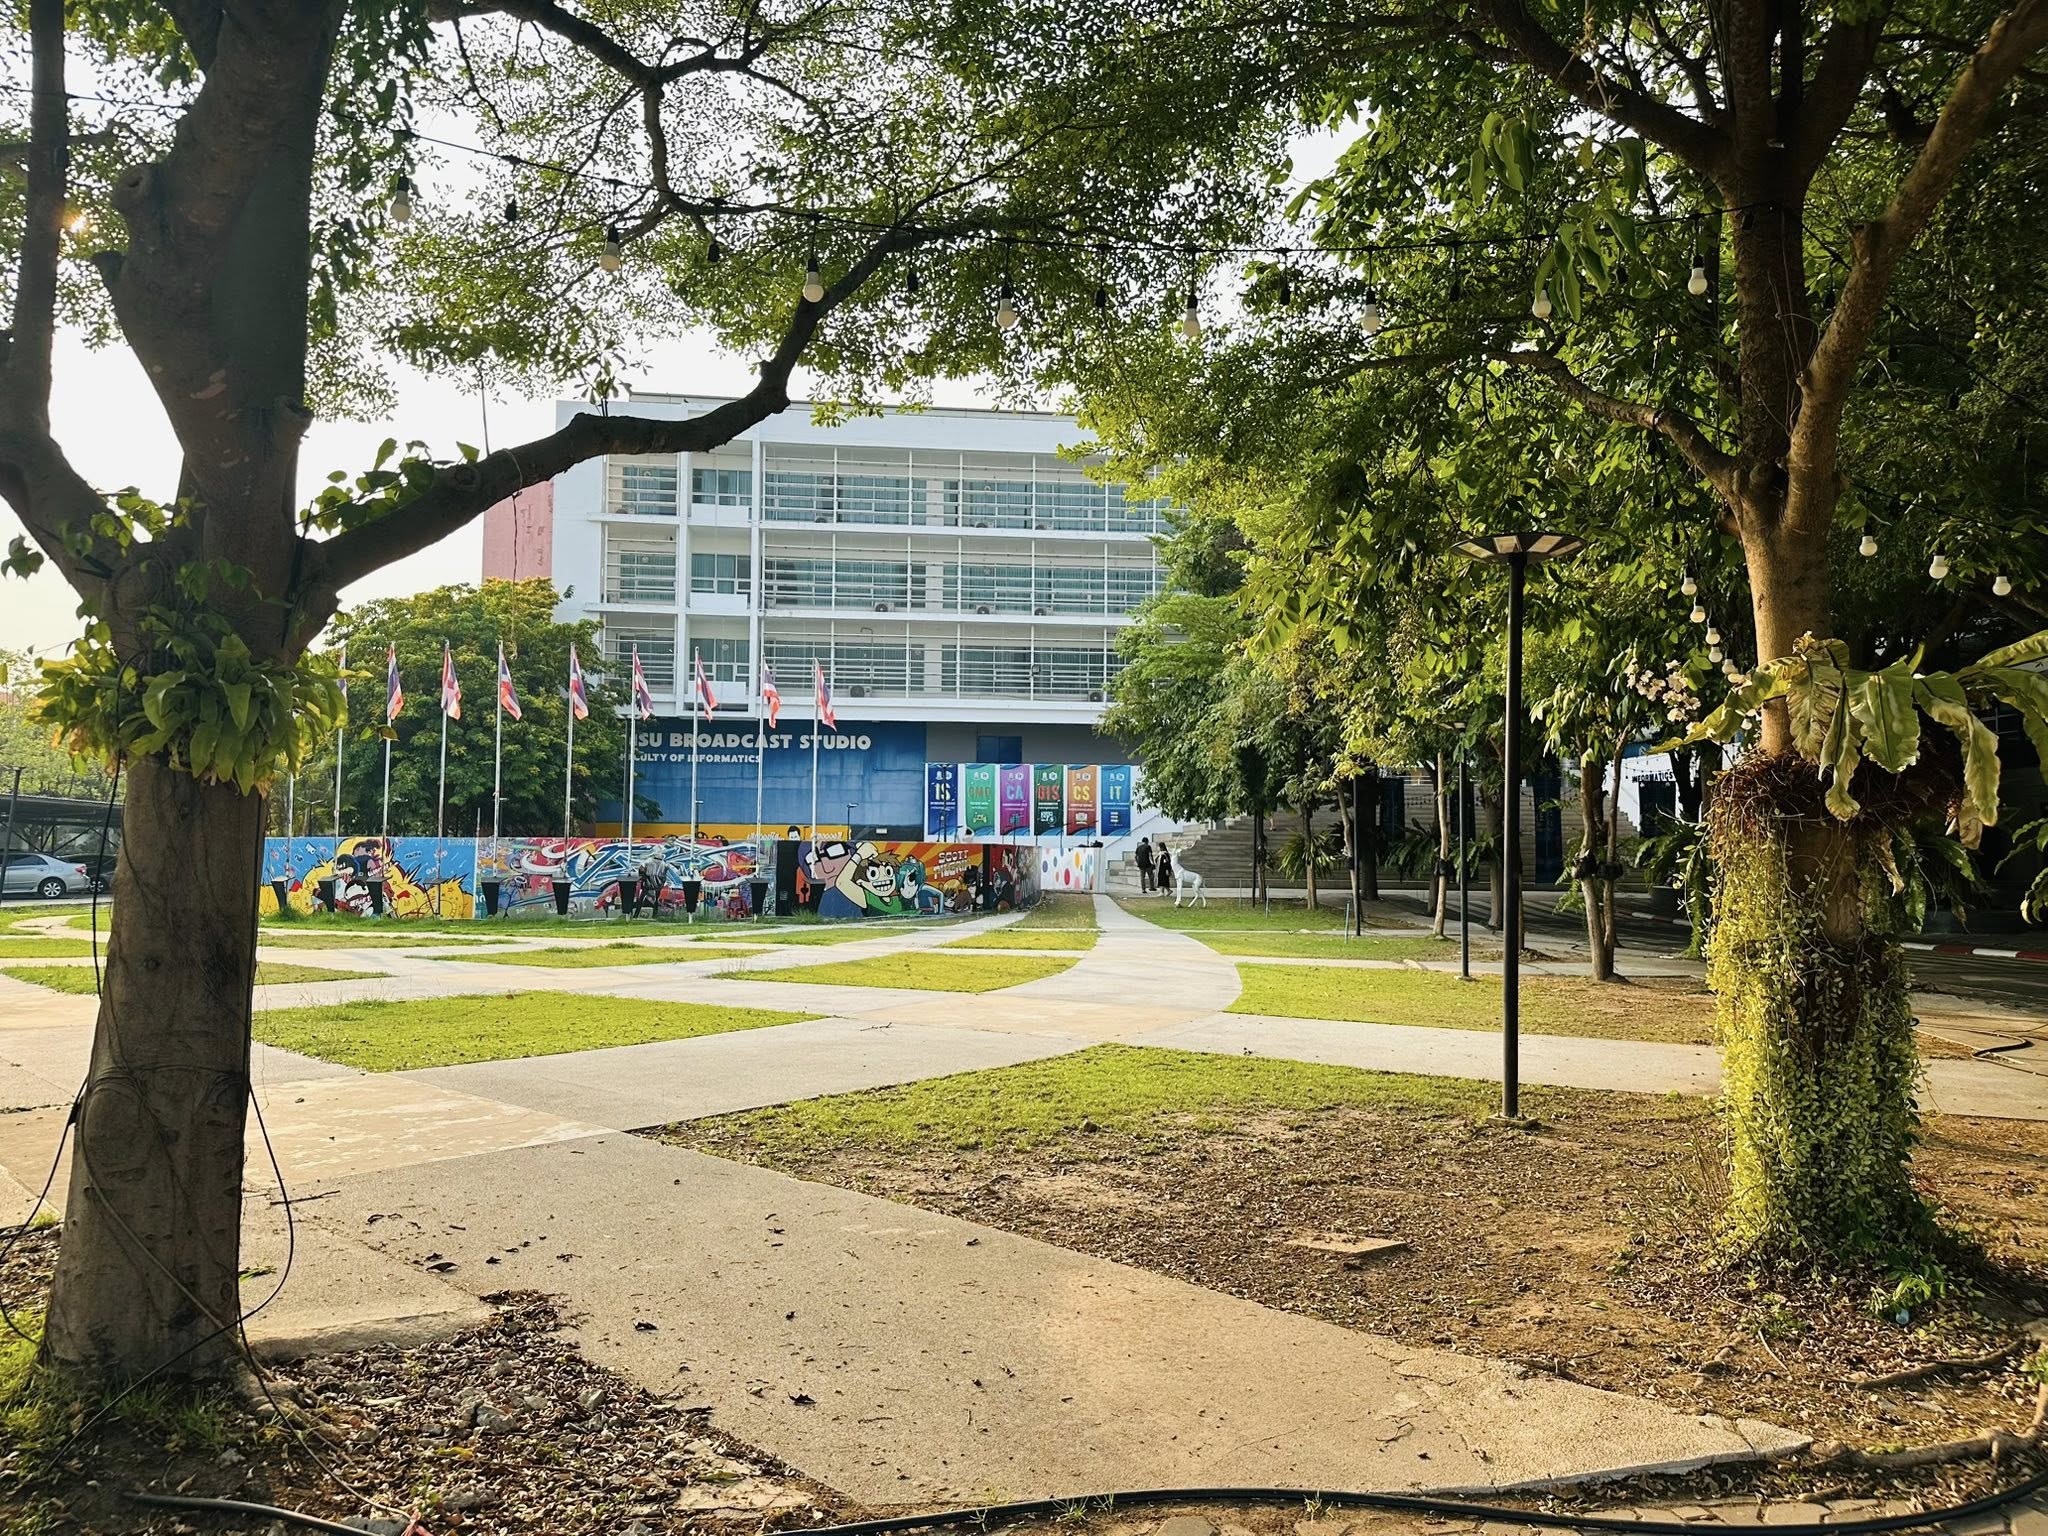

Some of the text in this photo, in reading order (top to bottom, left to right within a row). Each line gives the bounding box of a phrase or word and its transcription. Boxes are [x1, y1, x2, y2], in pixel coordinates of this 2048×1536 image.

[669, 732, 792, 749] BROADCAST
[799, 734, 871, 750] STUDIO
[622, 753, 667, 762] CULTY
[669, 753, 685, 762] OF
[1006, 784, 1023, 800] CA
[1038, 785, 1060, 800] GIS
[1073, 786, 1090, 800] CS
[1109, 786, 1122, 801] IT
[938, 849, 969, 864] SCOTT
